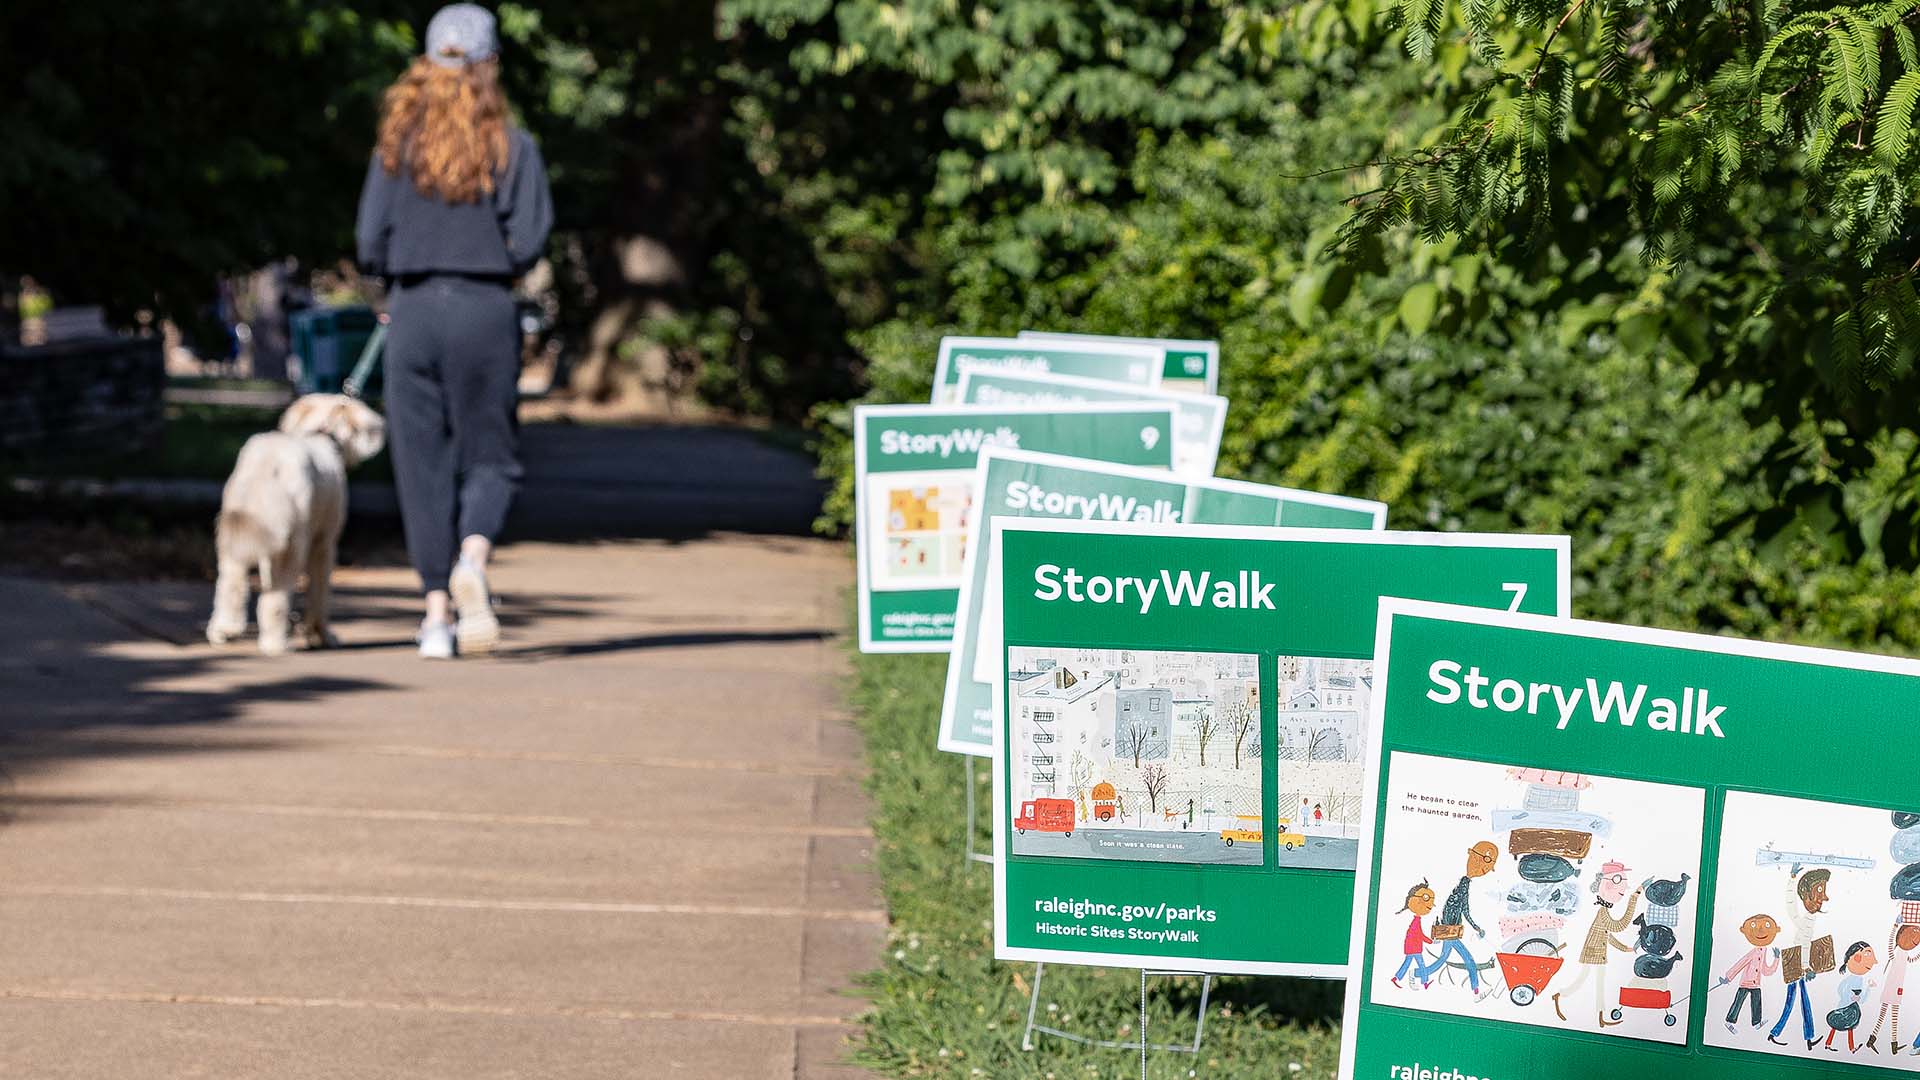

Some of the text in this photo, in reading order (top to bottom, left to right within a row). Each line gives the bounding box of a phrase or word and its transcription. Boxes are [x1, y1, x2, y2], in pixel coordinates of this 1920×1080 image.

[1140, 426, 1160, 450] 9
[1005, 480, 1181, 523] StoryWalk
[1033, 563, 1277, 614] StoryWalk
[1502, 582, 1528, 612] 7
[1425, 659, 1728, 738] StoryWalk
[1406, 792, 1418, 800] He
[1420, 795, 1444, 804] began
[1458, 800, 1479, 808] clear
[1401, 804, 1482, 822] the haunted garden.
[1099, 839, 1115, 847] Soon
[1035, 897, 1216, 924] raleighnc.gov/parks
[1036, 922, 1199, 944] Historic Sites StoryWalk
[1390, 1062, 1491, 1080] raleigh
